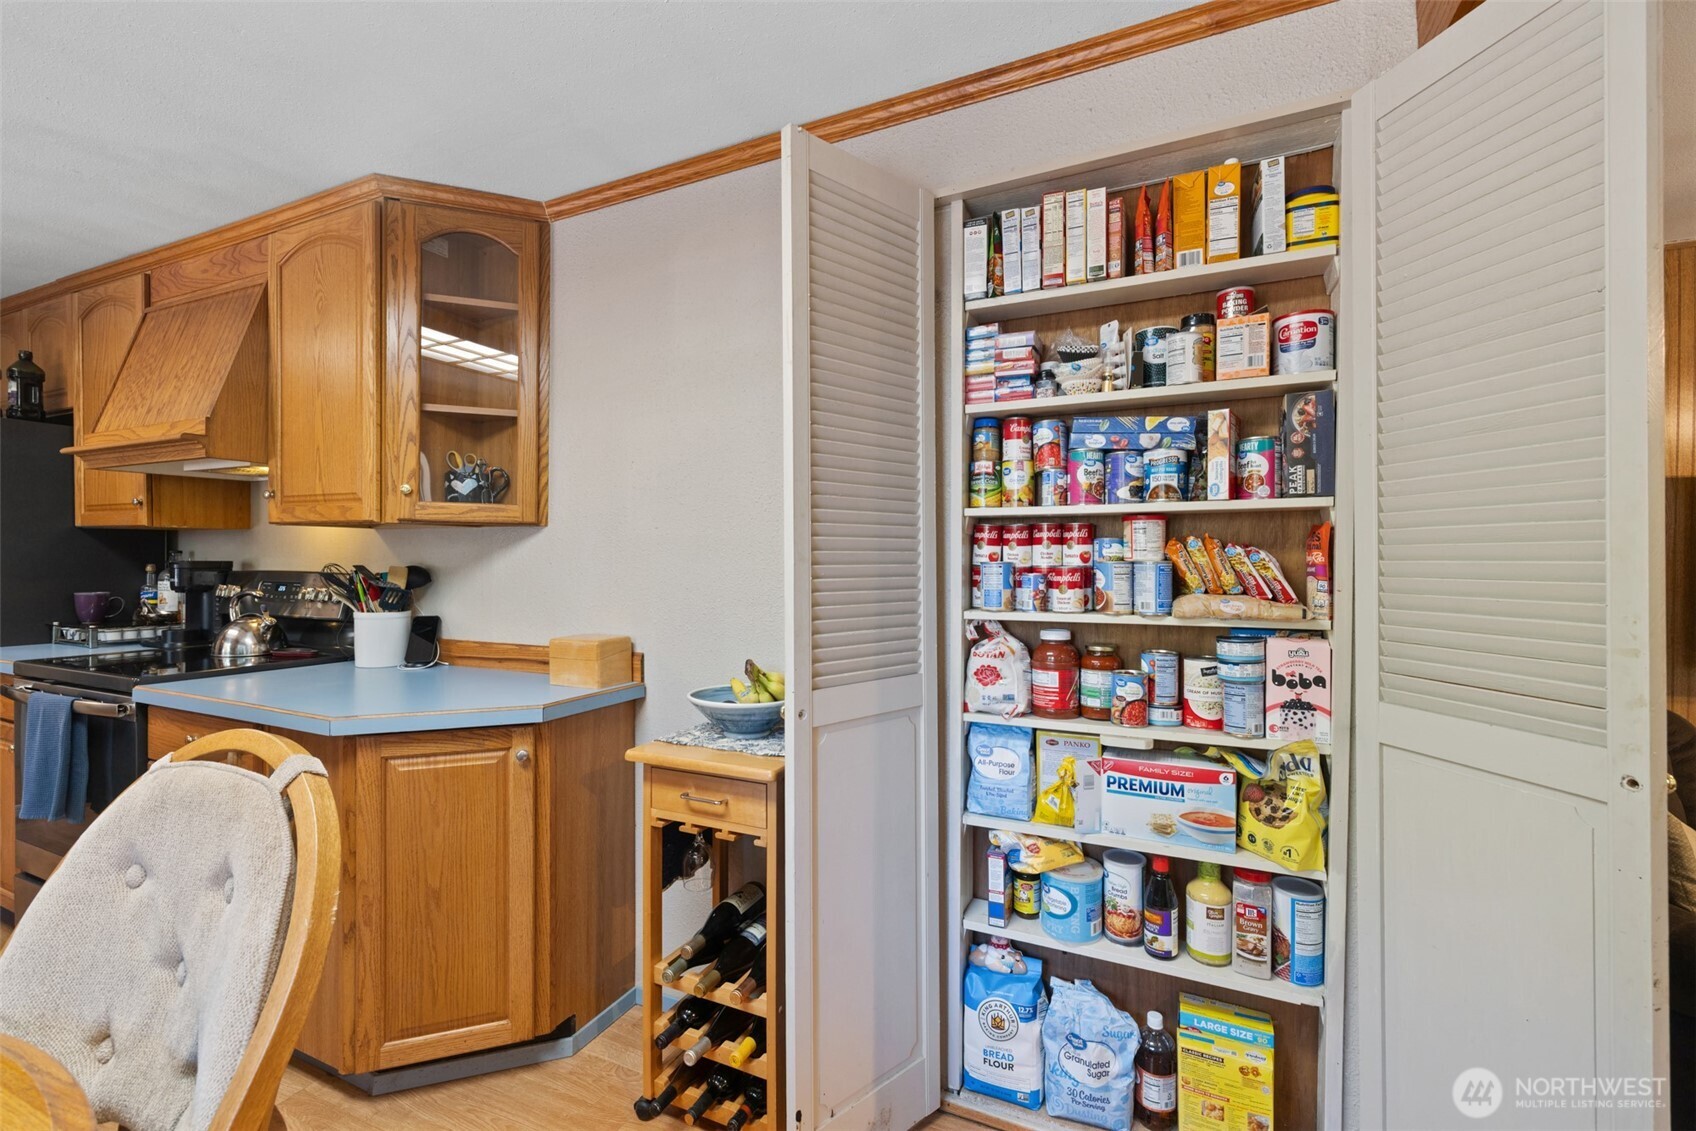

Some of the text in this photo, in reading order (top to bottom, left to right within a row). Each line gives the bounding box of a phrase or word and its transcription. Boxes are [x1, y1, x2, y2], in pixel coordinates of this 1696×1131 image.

[1288, 465, 1298, 494] PEAK
[1272, 669, 1327, 690] boba
[1063, 740, 1091, 748] PANKO
[977, 759, 1015, 769] All-Purpose
[1138, 765, 1194, 778] FAMILY SIZE!
[1106, 775, 1185, 798] PREMIUM
[1107, 889, 1128, 900] Crumbs
[1111, 886, 1128, 895] Bread
[1240, 918, 1263, 929] Brown
[1242, 925, 1259, 934] Gravy
[981, 1002, 1016, 1023] KING ARTHUR
[1193, 1018, 1253, 1041] LARGE SIZE
[983, 1048, 1014, 1062] BREAD
[1063, 1051, 1111, 1069] Granulated
[983, 1057, 1014, 1071] FLOUR
[1087, 1068, 1110, 1080] Sugar
[1066, 1087, 1111, 1105] 30 Calories
[1082, 1101, 1106, 1112] Serving
